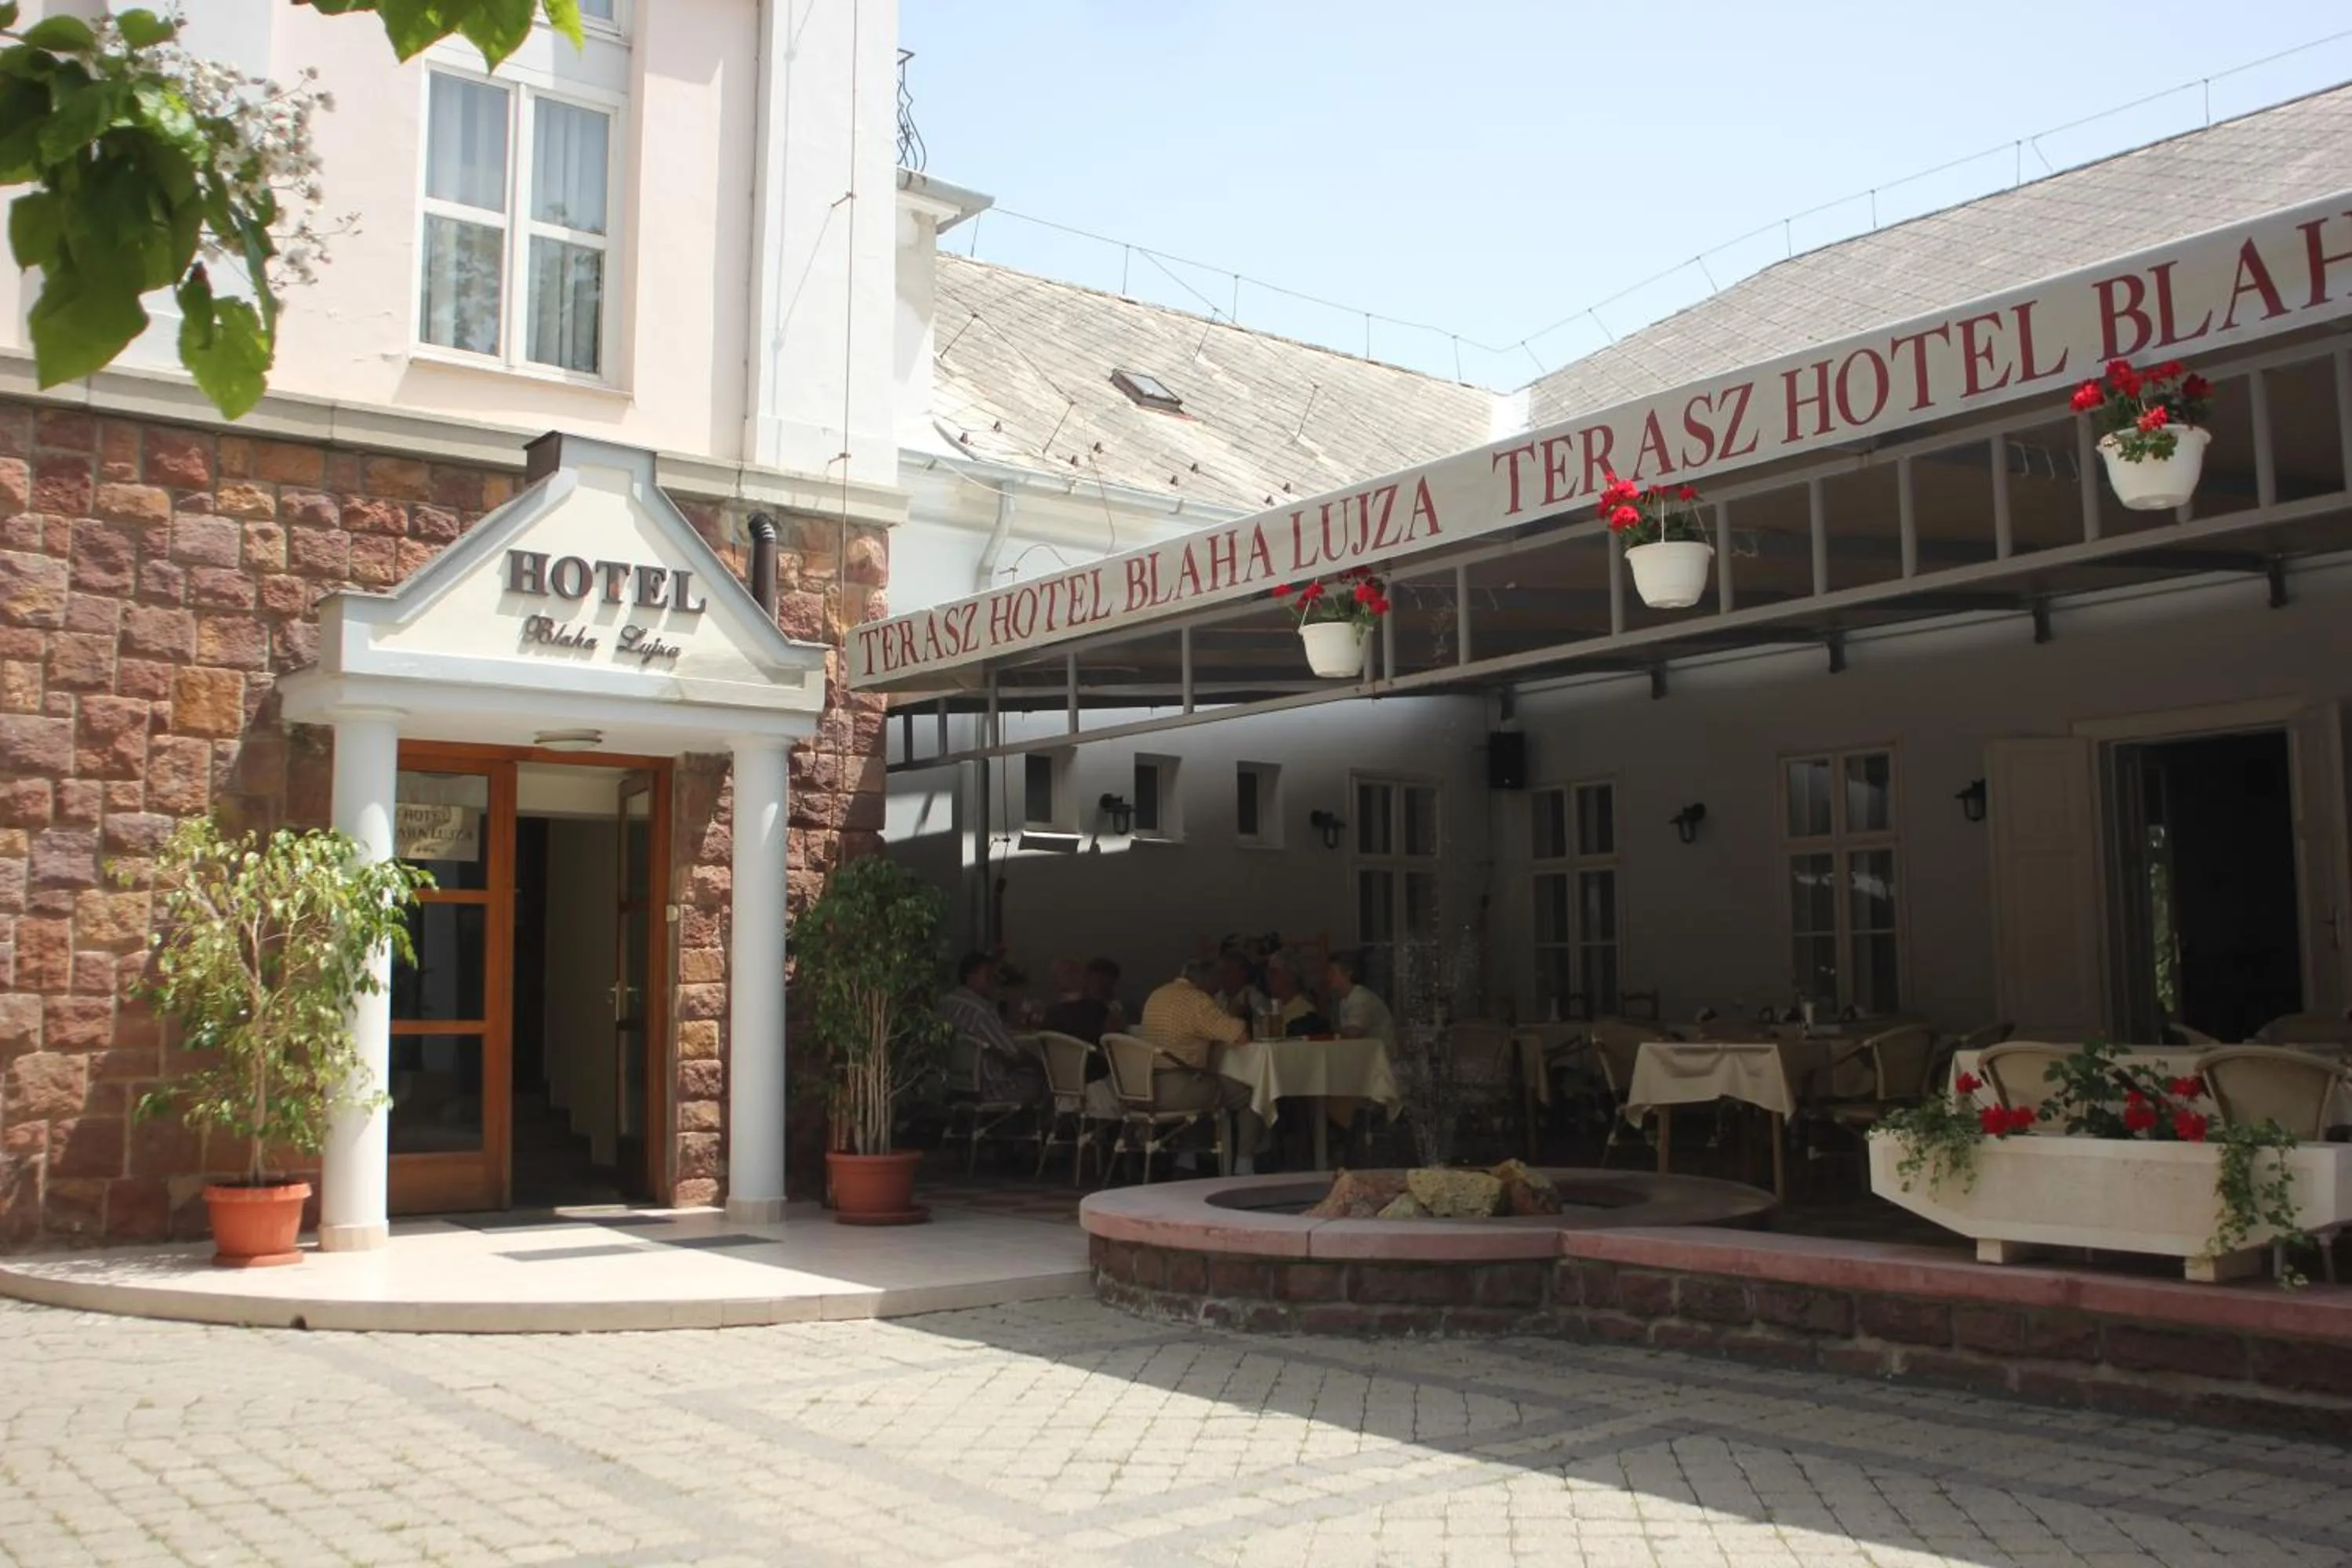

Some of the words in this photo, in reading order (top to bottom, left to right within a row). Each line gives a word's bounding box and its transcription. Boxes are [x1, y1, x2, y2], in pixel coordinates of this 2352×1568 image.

[858, 601, 980, 676] TERASZ
[989, 568, 1113, 646] HOTEL
[1123, 522, 1276, 613] BLAHA
[1289, 474, 1443, 572] LUJZA
[1492, 382, 1760, 516] TERASZ
[1780, 301, 2069, 445] HOTEL
[505, 549, 706, 613] HOTEL
[524, 614, 597, 651] Blaha
